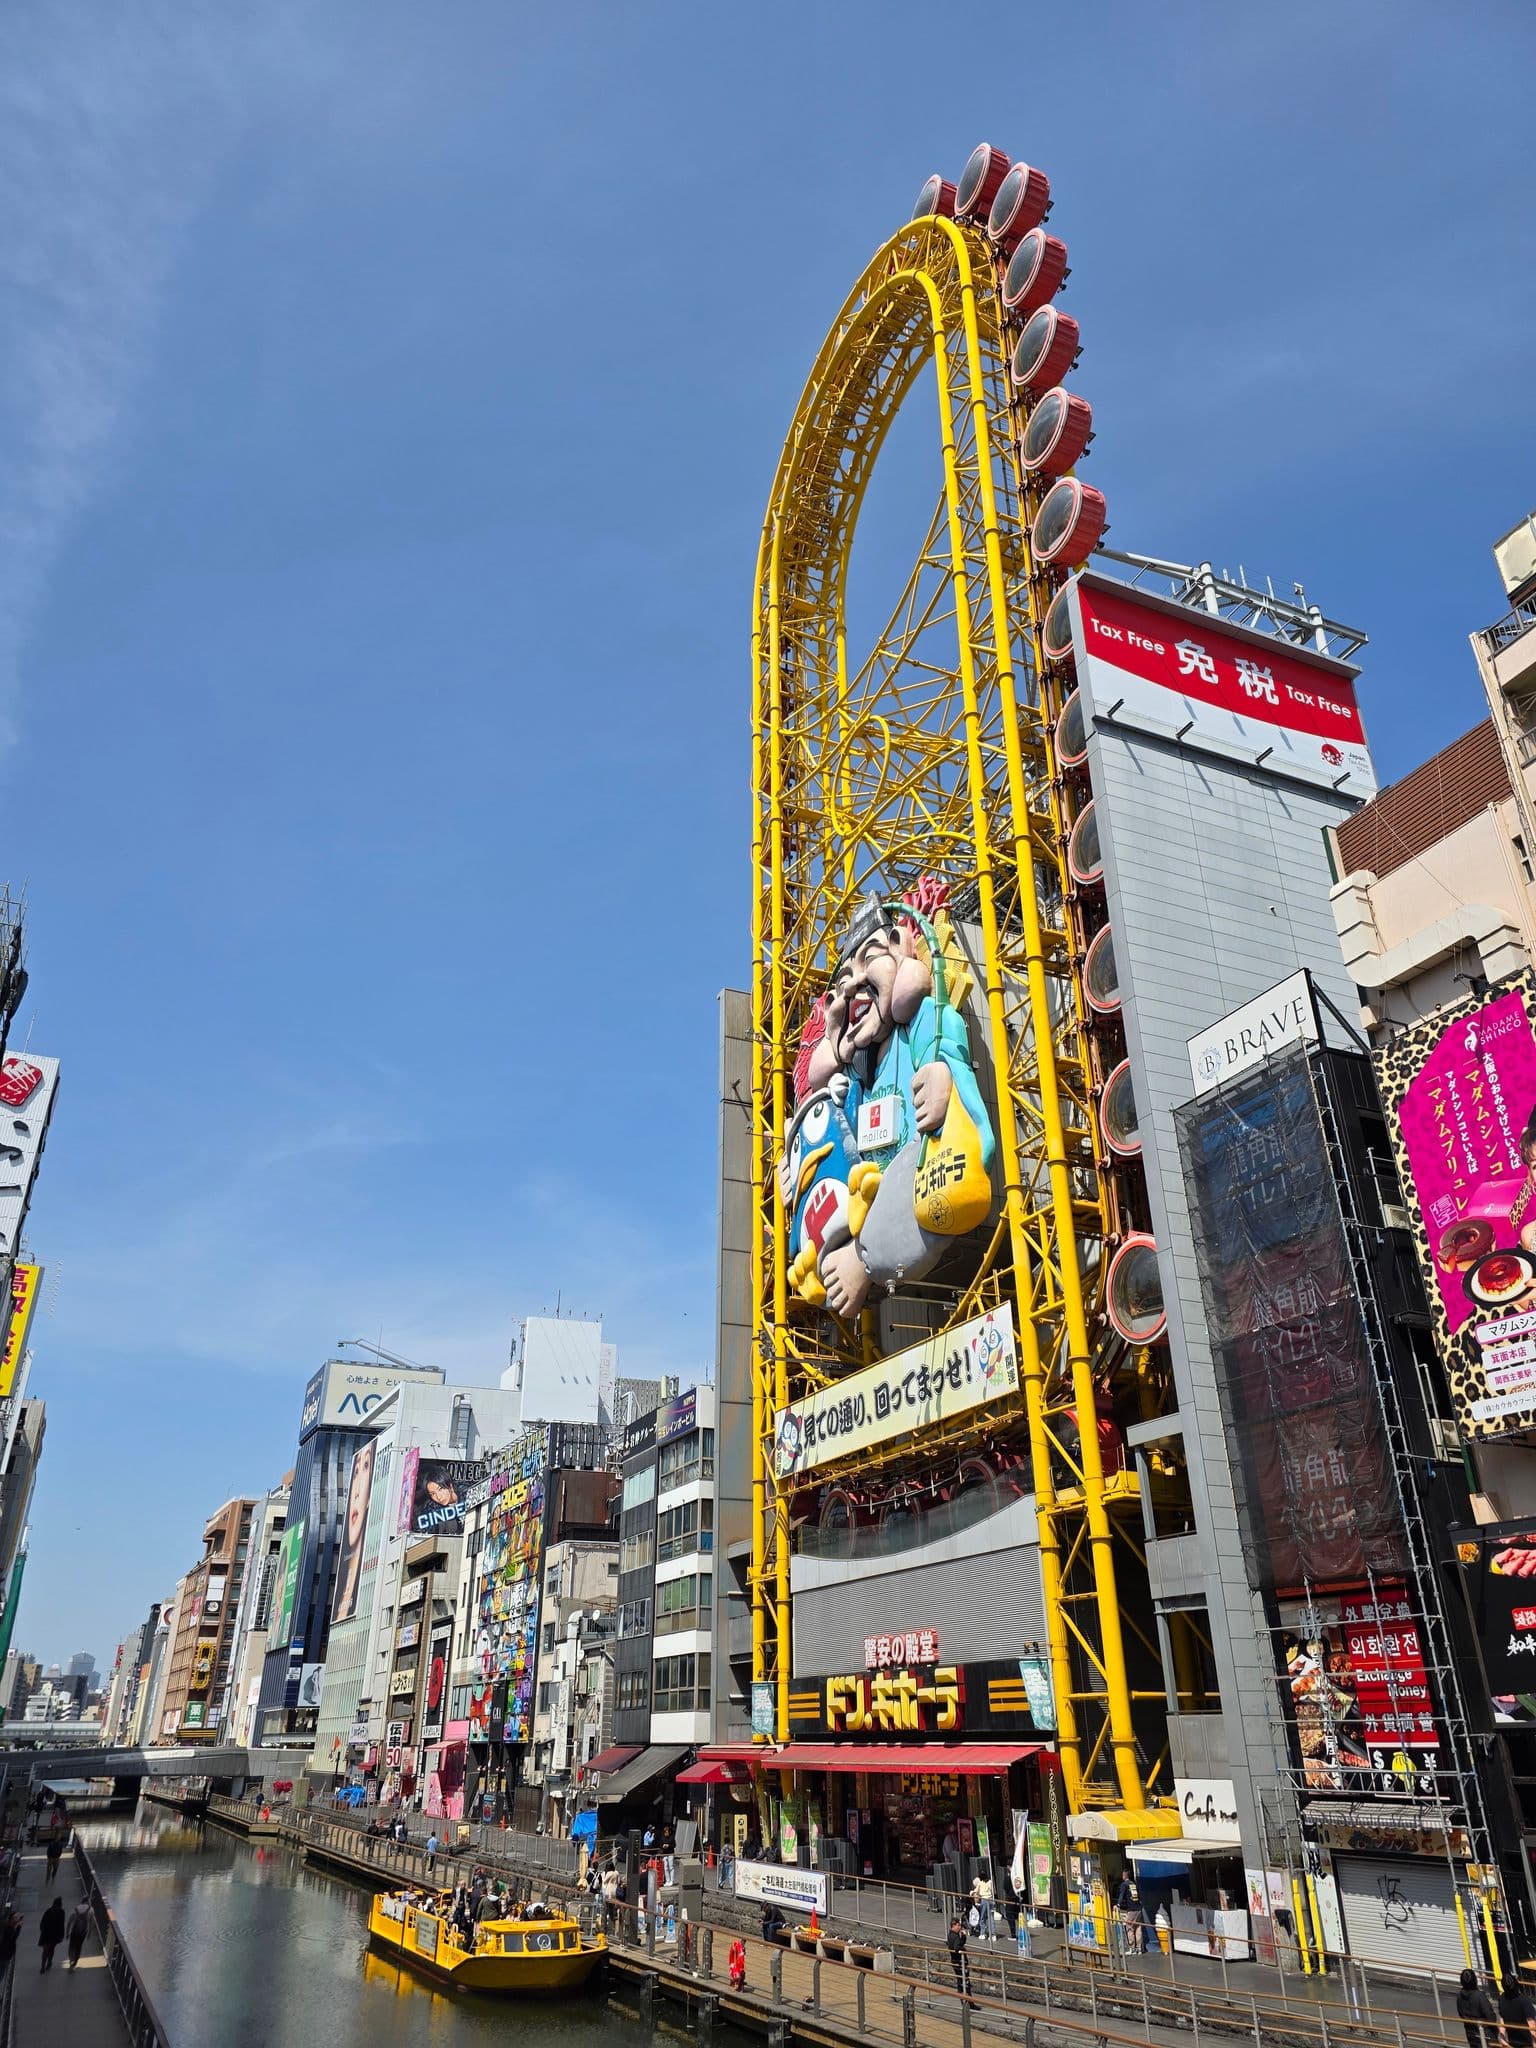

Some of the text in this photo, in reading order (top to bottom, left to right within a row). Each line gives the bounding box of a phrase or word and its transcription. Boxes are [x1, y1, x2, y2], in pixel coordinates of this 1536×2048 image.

[1090, 618, 1166, 656] Tax Free
[1285, 684, 1353, 719] Tax Free
[1224, 996, 1307, 1066] BRAVE
[1478, 1010, 1520, 1036] MADAME
[1480, 1020, 1522, 1045] SHINCO
[1445, 1070, 1479, 1174] マダムシンコといえば
[1482, 1052, 1522, 1170] 大阪のおみやげといえば
[1491, 1346, 1527, 1364] 箕面本店
[863, 1630, 937, 1669] 驚安の殿堂
[1350, 1631, 1419, 1659] 외화환전
[1388, 1684, 1427, 1699] Money
[386, 1748, 400, 1766] 50
[1184, 1791, 1216, 1823] Cafe
